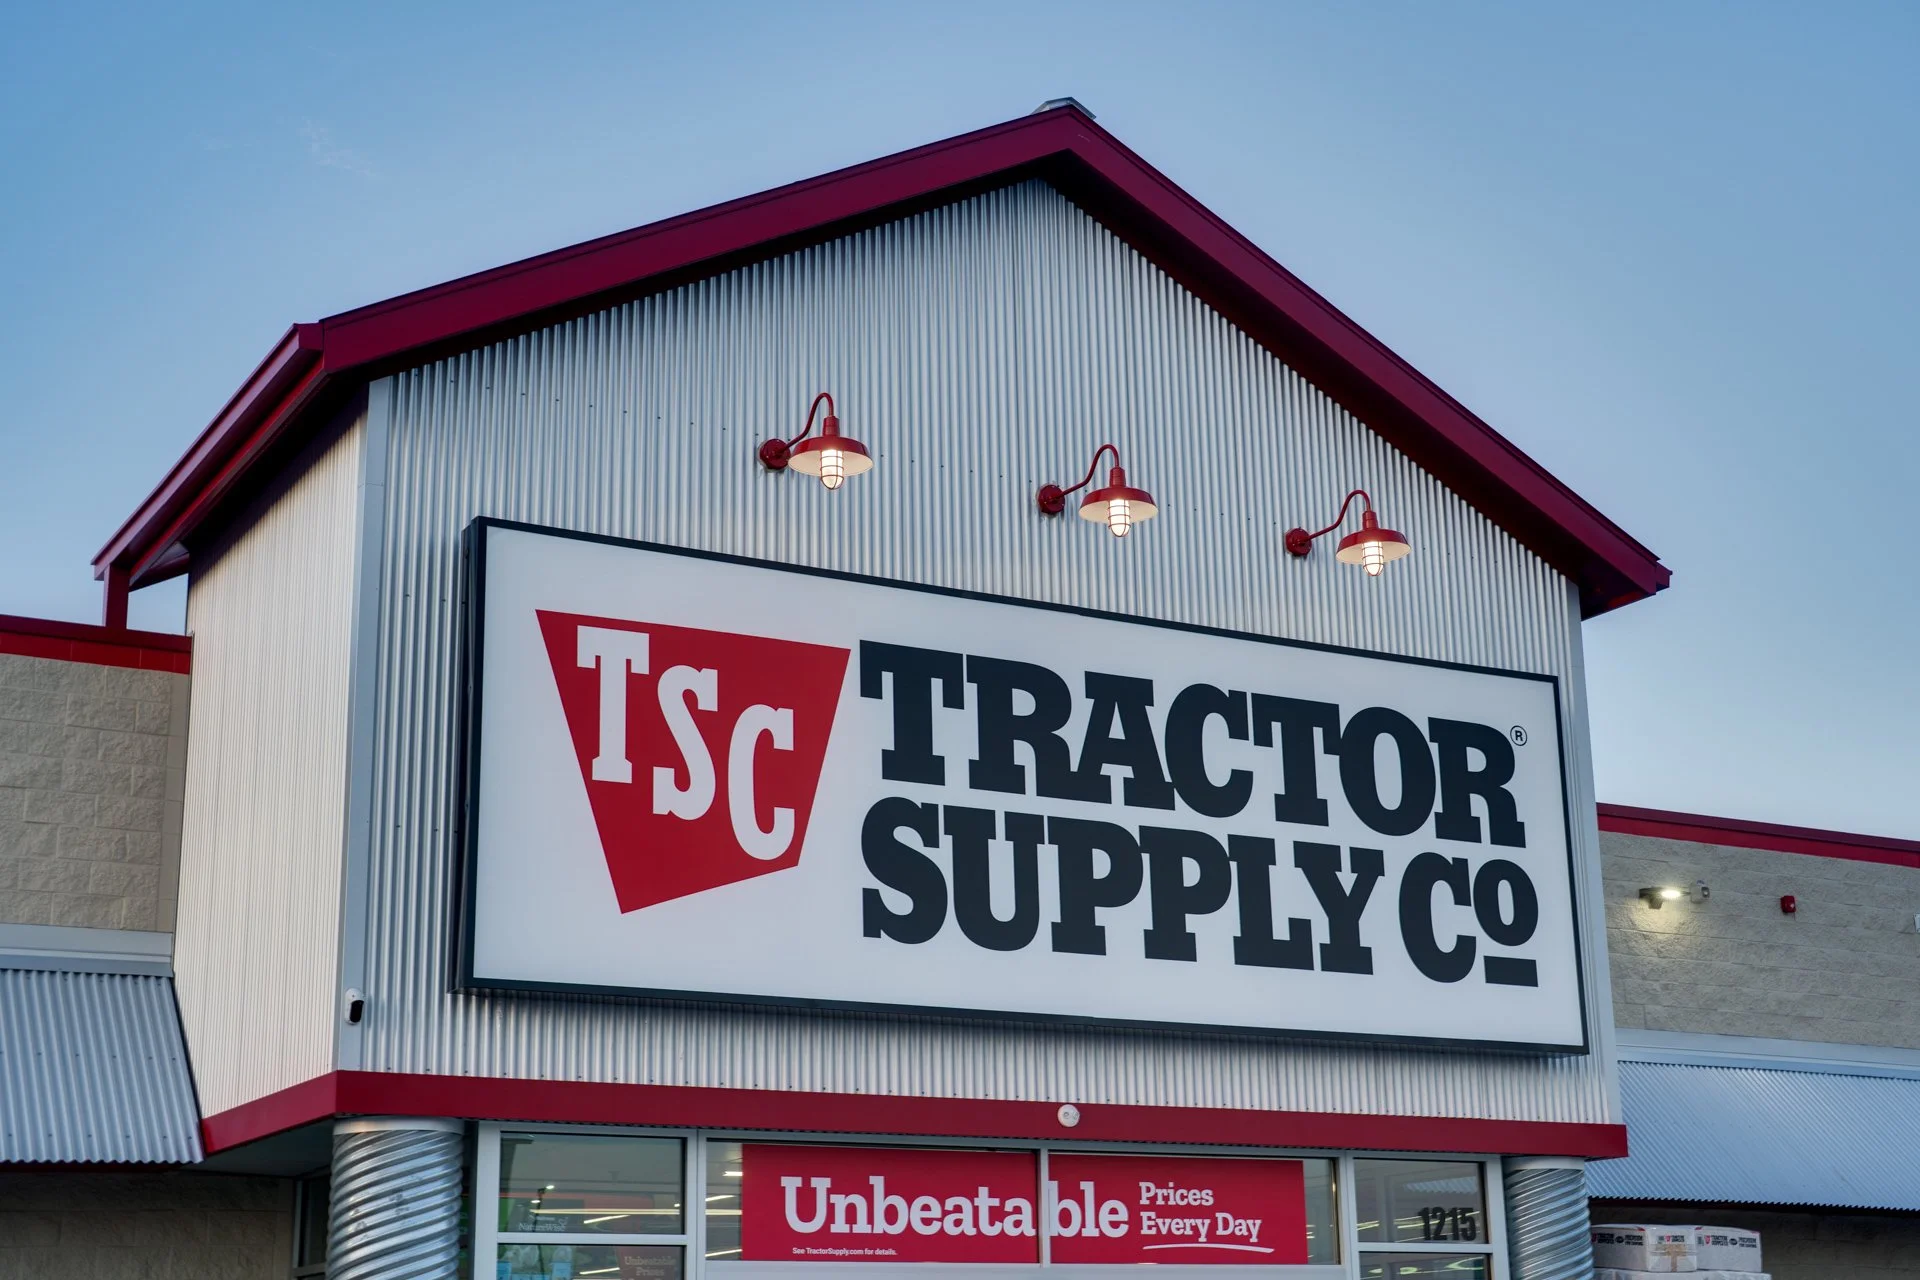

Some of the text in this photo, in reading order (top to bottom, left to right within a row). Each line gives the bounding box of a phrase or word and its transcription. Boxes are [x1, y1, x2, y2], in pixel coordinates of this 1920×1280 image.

[577, 624, 795, 861] TSC
[859, 639, 1527, 849] TRACTOR
[861, 797, 1385, 976] SUPPLY
[780, 1175, 1130, 1238] Unbeatable
[1138, 1181, 1214, 1206] Prices
[1139, 1211, 1262, 1243] Every Day
[1417, 1206, 1477, 1242] 1215
[792, 1247, 805, 1255] See
[864, 1247, 874, 1255] for
